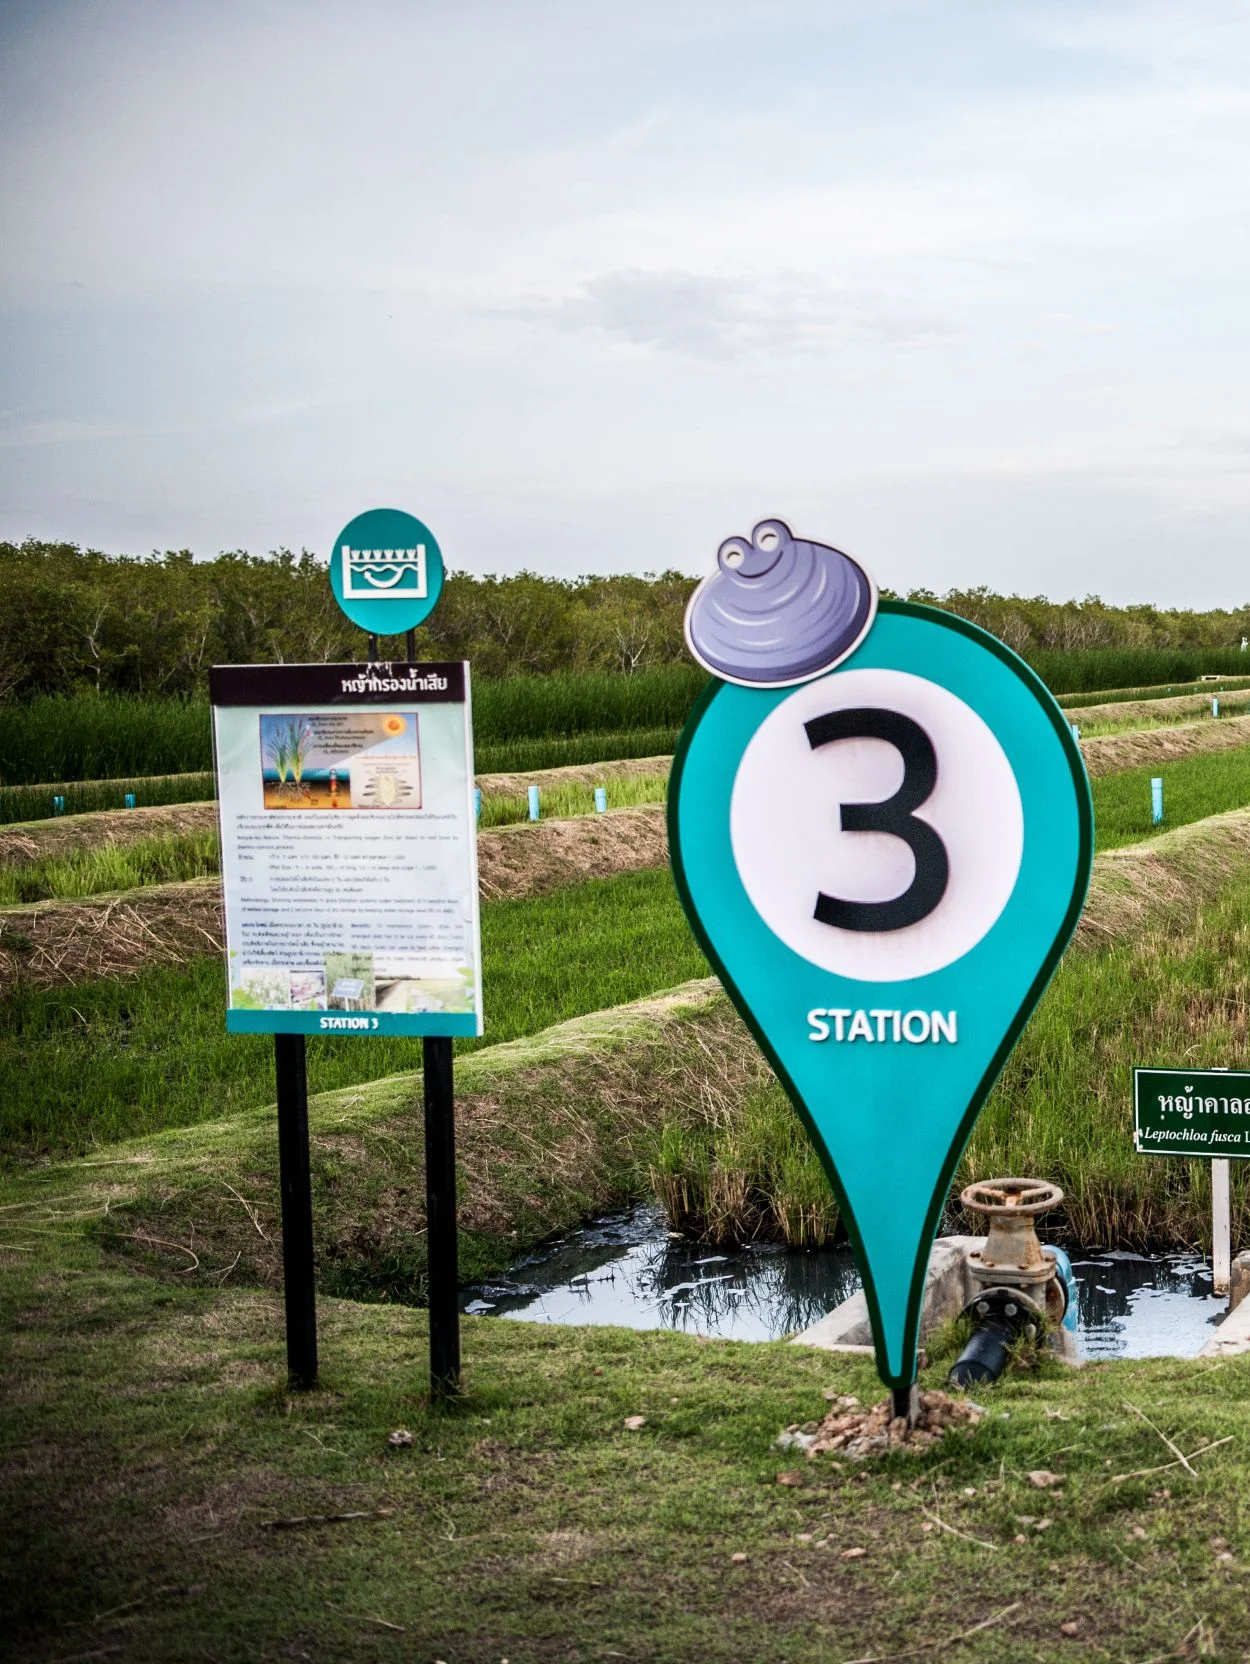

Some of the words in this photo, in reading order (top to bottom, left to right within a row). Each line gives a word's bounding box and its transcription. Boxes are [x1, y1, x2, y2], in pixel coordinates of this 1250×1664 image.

[803, 707, 950, 932] 3
[320, 1017, 369, 1029] STATION
[807, 1008, 959, 1045] STATION
[1144, 1126, 1208, 1142] Leptochloa
[1208, 1129, 1242, 1145] fusca
